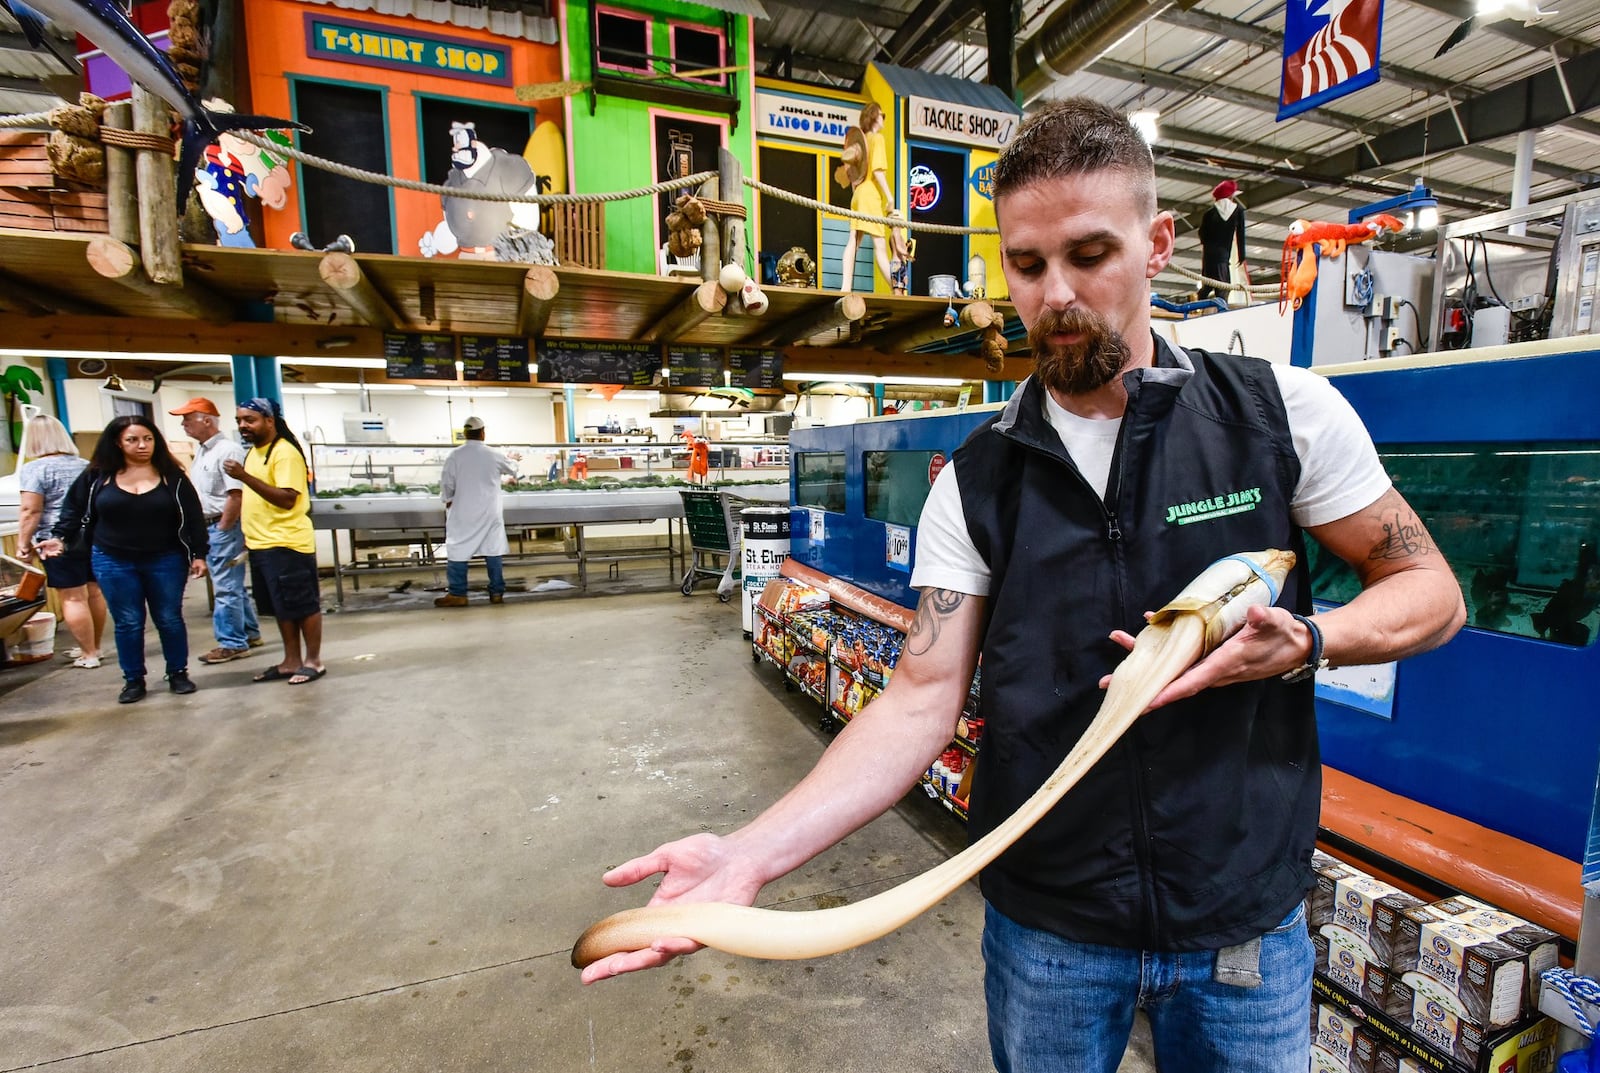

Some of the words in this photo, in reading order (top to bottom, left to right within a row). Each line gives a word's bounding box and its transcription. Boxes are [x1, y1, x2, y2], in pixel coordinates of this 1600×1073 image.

[321, 27, 424, 63] T-SHIRT
[435, 46, 499, 74] SHOP
[768, 113, 810, 131] TATOO
[779, 105, 824, 118] JUNGLE
[827, 112, 848, 122] INK
[923, 106, 964, 132] TACKLE
[968, 114, 999, 138] SHOP
[546, 340, 557, 348] We
[560, 341, 579, 349] Clean
[633, 344, 649, 352] FREE
[1166, 496, 1226, 522] JUNGLE
[1226, 487, 1262, 507] JIM'S
[746, 549, 759, 563] St.
[1337, 908, 1367, 929] CLAM
[1331, 966, 1360, 988] CLAM
[1421, 961, 1456, 984] CHOWDER
[1422, 954, 1457, 980] CLAM
[1320, 1030, 1348, 1053] CLAM
[1366, 1015, 1400, 1041] AMERICA'S
[1401, 1038, 1411, 1049] #1
[1412, 1044, 1429, 1062] FISH
[1430, 1057, 1445, 1071] FRY
[1416, 1018, 1451, 1045] CLAM
